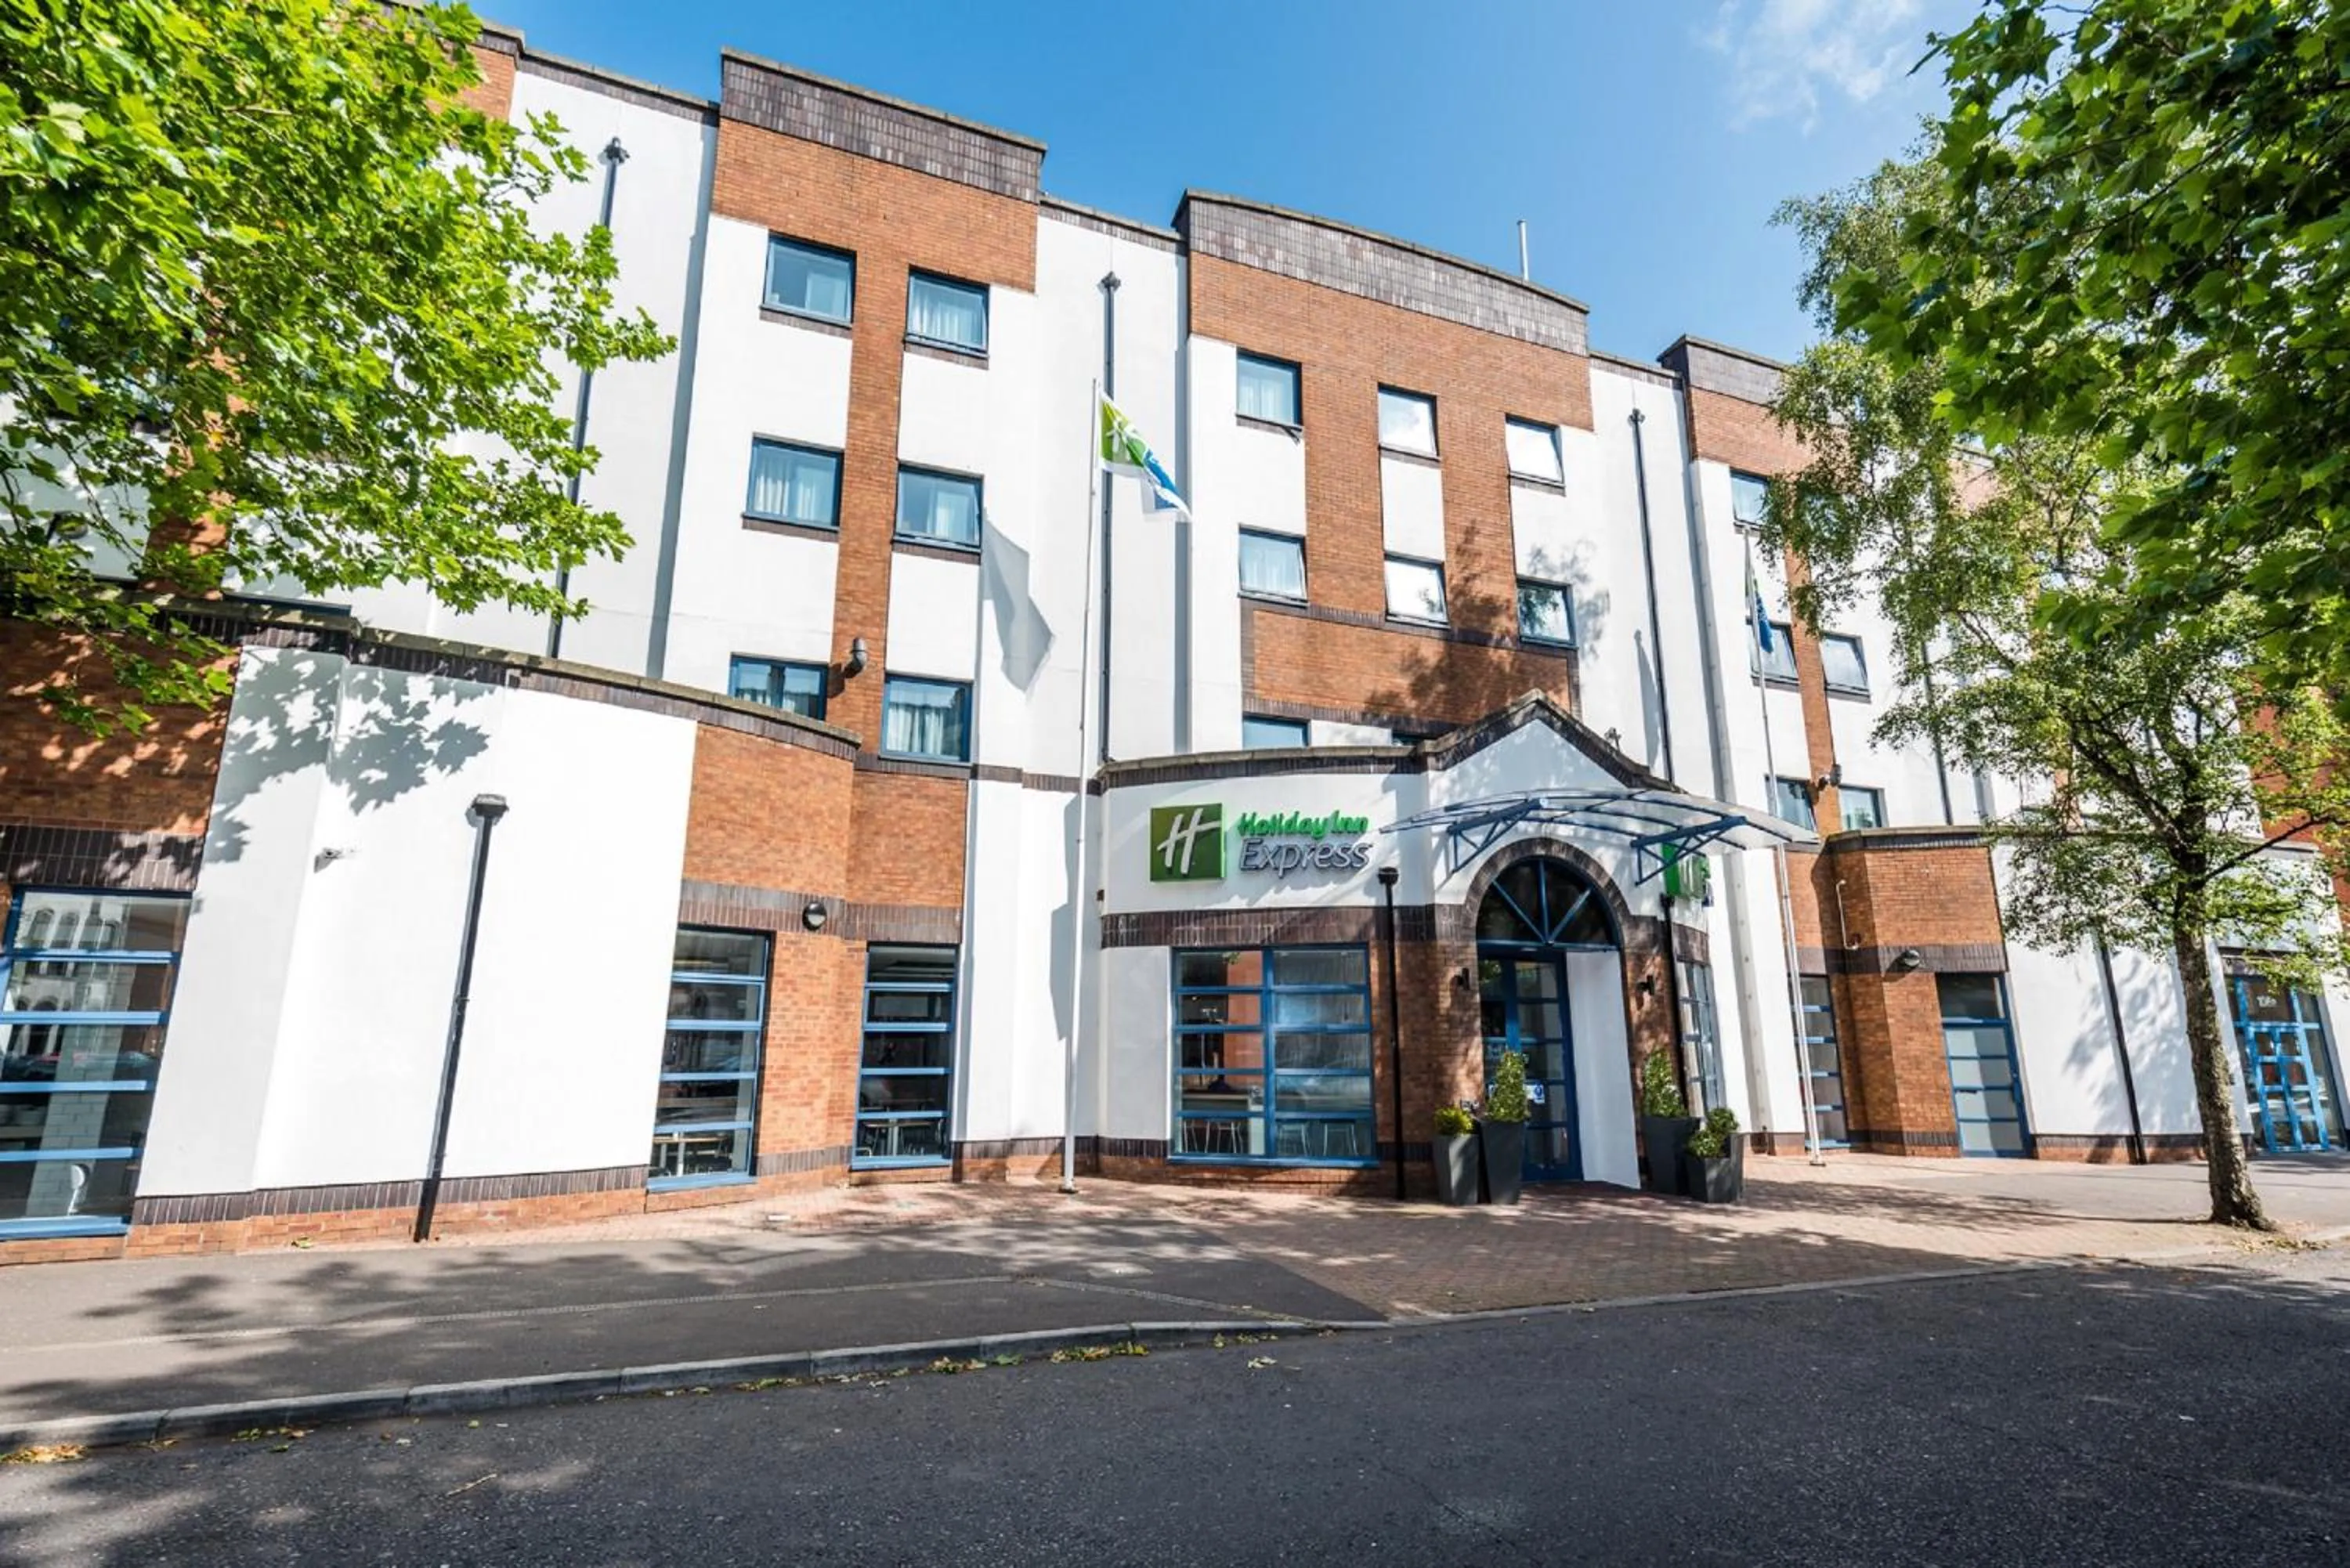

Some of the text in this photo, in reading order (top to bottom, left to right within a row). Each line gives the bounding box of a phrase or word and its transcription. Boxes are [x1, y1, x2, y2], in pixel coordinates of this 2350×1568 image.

[1157, 807, 1220, 875] H
[1238, 809, 1368, 839] Holiday Inn
[1240, 837, 1372, 879] Express
